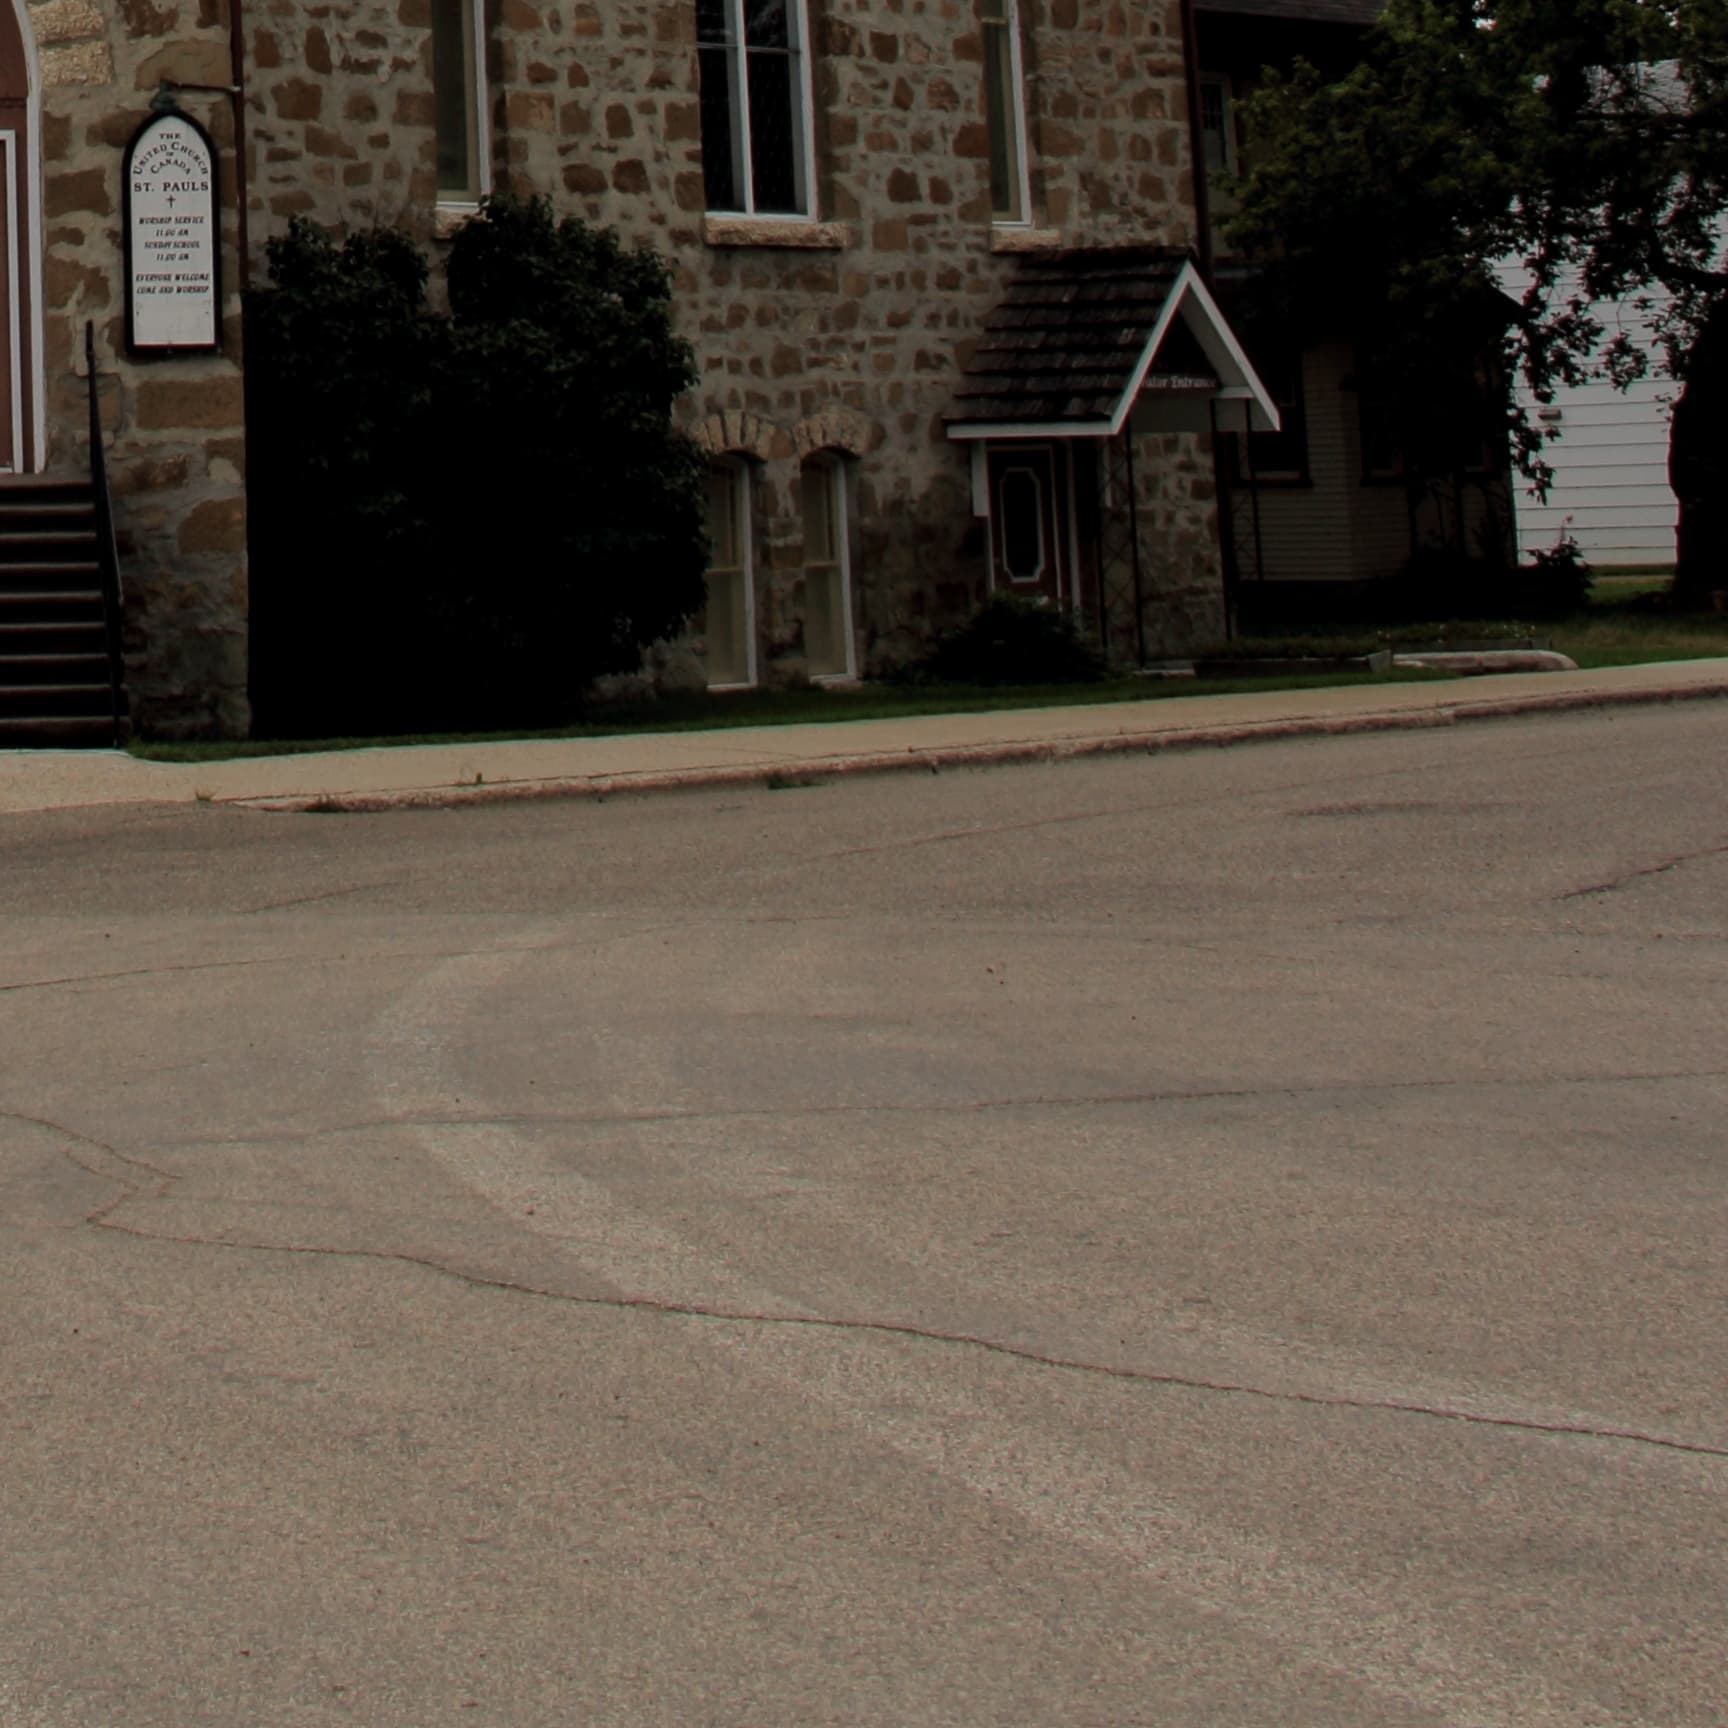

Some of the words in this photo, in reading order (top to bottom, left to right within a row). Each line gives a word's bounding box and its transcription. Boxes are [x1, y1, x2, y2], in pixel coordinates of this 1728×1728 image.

[133, 144, 167, 175] UNITED
[171, 141, 208, 175] CHURCH
[150, 158, 191, 175] CANADA
[134, 182, 154, 192] ST.
[163, 181, 209, 192] PAULS
[139, 216, 172, 224] WORSHIP
[174, 216, 204, 224] SERVICE
[144, 241, 171, 249] SUNDAY
[173, 240, 200, 248] SCHOOL
[136, 273, 172, 281] EVERYONE
[175, 273, 209, 281] WELCOME
[159, 286, 174, 294] AND
[176, 286, 210, 294] WORSHIP
